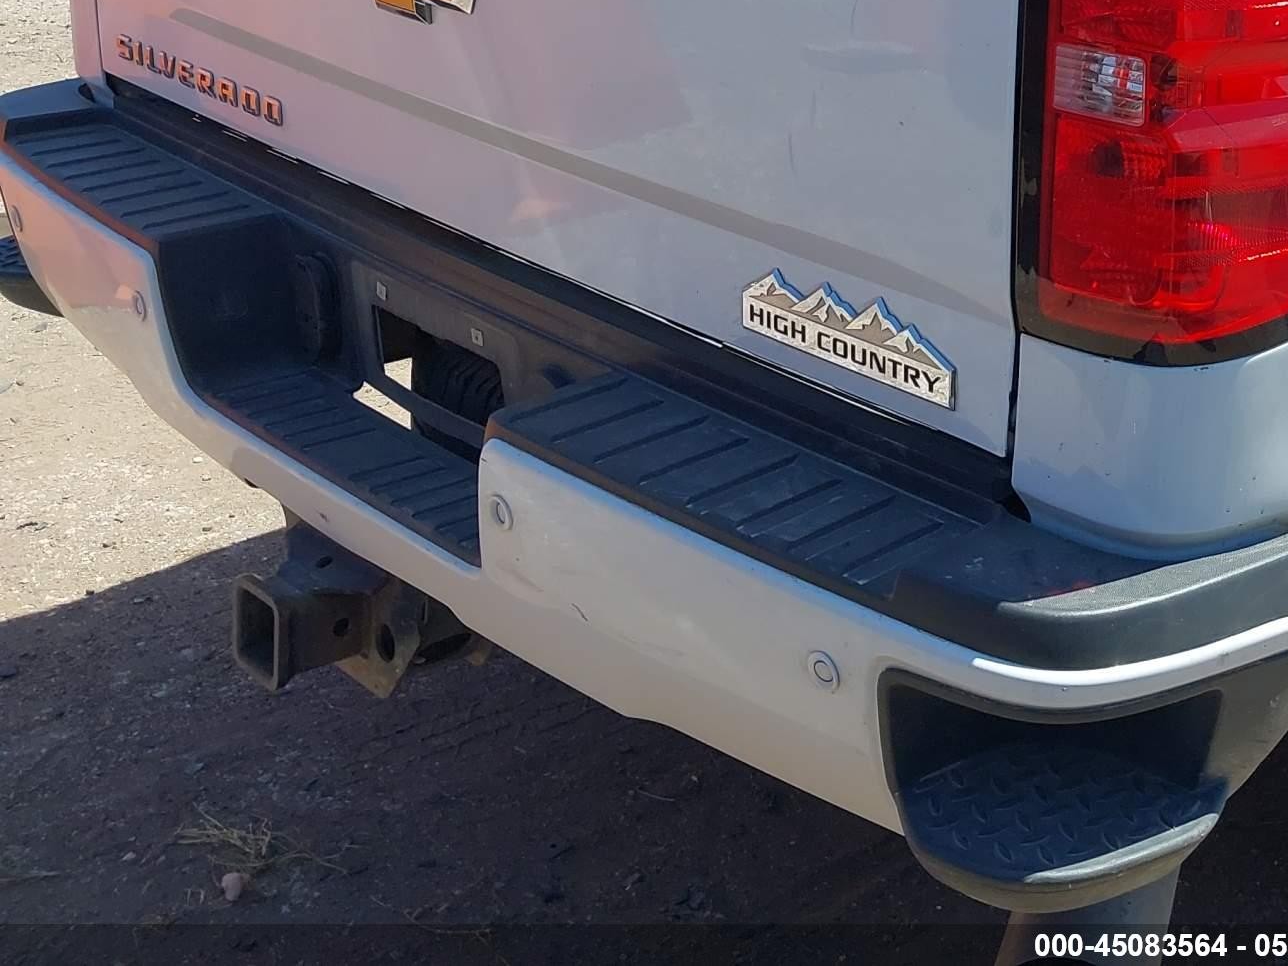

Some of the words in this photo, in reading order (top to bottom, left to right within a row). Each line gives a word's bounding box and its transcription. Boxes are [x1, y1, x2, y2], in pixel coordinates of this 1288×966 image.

[115, 33, 283, 126] SILVERADO
[749, 303, 807, 344] HIGH
[816, 330, 941, 394] COUNTRY
